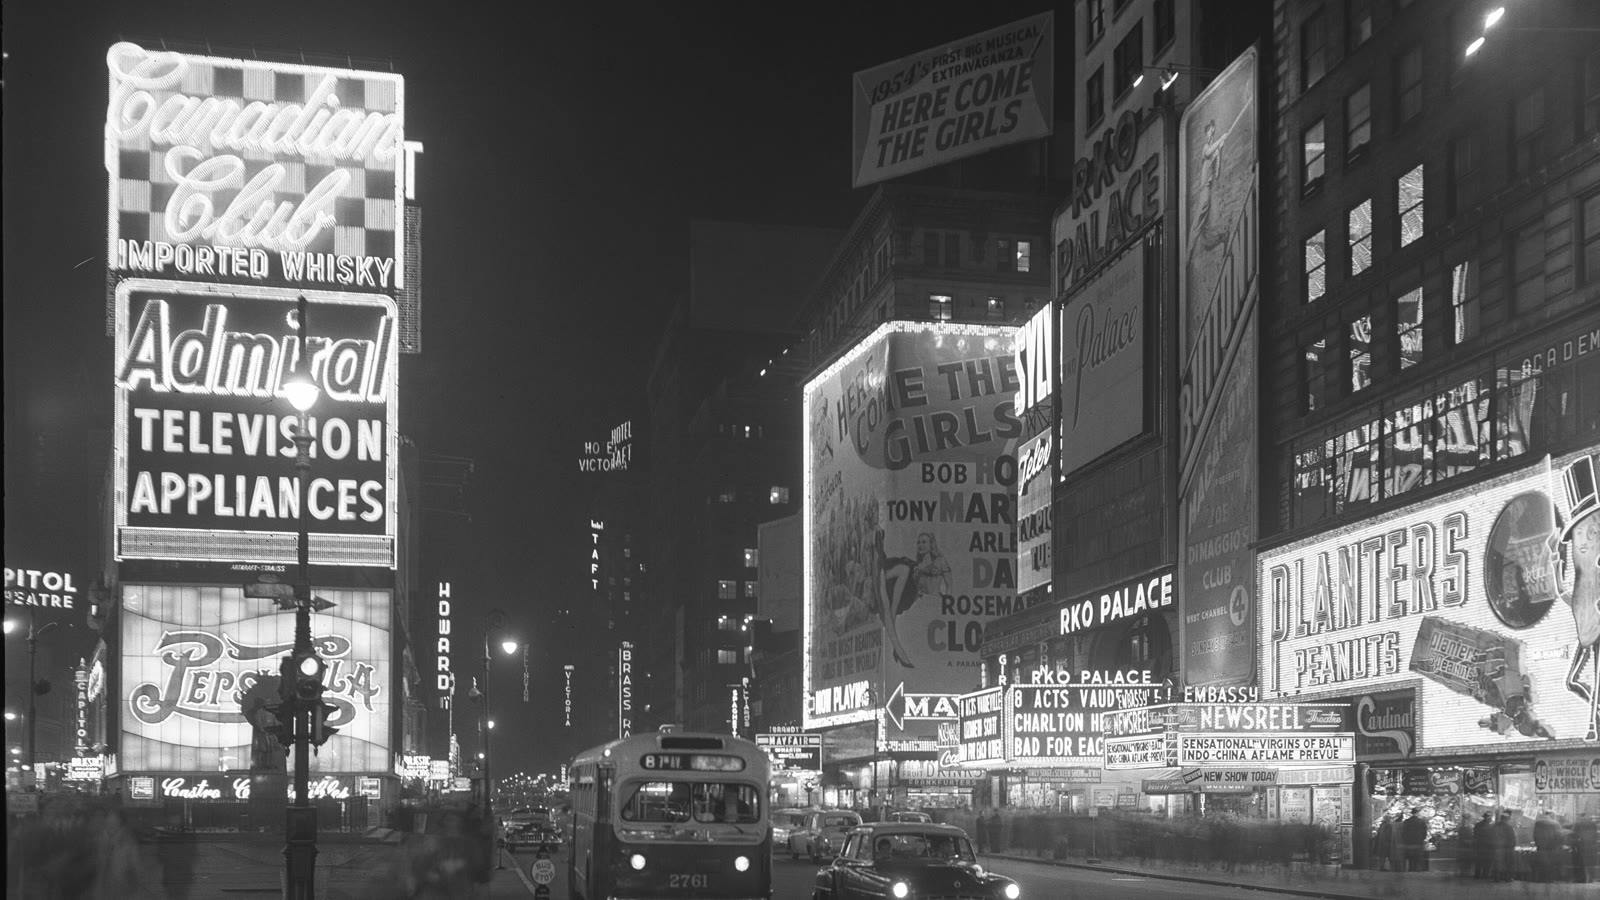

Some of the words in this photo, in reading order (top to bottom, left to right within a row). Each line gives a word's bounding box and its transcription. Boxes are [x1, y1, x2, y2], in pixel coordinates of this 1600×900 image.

[870, 60, 930, 106] 1954's
[932, 49, 961, 70] FIRST
[964, 42, 982, 59] BIG
[986, 24, 1040, 51] MUSICAL
[932, 46, 1024, 84] EXTRAVAGANZA
[106, 41, 400, 163] Canadian
[880, 86, 950, 135] HERE
[954, 60, 1035, 113] COME
[876, 125, 929, 169] THE
[935, 100, 1023, 151] GIRLS
[1071, 109, 1143, 220] RKO
[164, 145, 350, 251] Club
[1056, 152, 1160, 297] PALACE
[117, 238, 269, 279] IMPORTED
[280, 249, 394, 288] WHISKY
[115, 299, 395, 404] Admiral
[1072, 302, 1138, 433] Palace
[937, 353, 1018, 401] THE
[134, 407, 383, 462] TELEVISION
[611, 420, 632, 446] HOTEL
[884, 399, 1023, 472] GIRLS
[578, 458, 628, 472] VICTORA
[921, 462, 967, 484] BOB
[130, 470, 384, 523] APPLIANCES
[886, 500, 937, 523] TONY
[591, 533, 599, 590] TAFT
[1060, 599, 1094, 636] RKO
[1100, 573, 1174, 624] PALACE
[1232, 589, 1246, 621] 4
[1270, 510, 1468, 692] PLANTERS
[437, 582, 451, 691] HOWARD
[1293, 631, 1401, 691] PEANUTS
[622, 650, 633, 711] BRASS
[1031, 670, 1071, 685] RKO
[1080, 670, 1152, 685] PALACE
[1014, 689, 1023, 709] 8
[1034, 689, 1069, 709] ACTS
[1184, 686, 1260, 704] EMBASSY
[76, 682, 87, 747] CAPITOL
[1014, 712, 1084, 733] CHARLTON
[1113, 710, 1151, 736] NEWSREEL
[1200, 705, 1305, 731] NEWSREEL
[1357, 695, 1415, 750] Cardinal
[769, 736, 810, 746] MAYFAIR
[1014, 736, 1040, 757] BAD
[1048, 736, 1073, 757] FOR
[1251, 749, 1294, 760] AFLAME
[1299, 749, 1340, 760] PREVUE
[1303, 739, 1316, 749] OF
[645, 755, 655, 769] 8
[926, 762, 983, 779] DRINKS
[1203, 771, 1222, 783] NEW
[1224, 771, 1249, 783] SHOW
[1251, 770, 1278, 783] TODAY
[1556, 767, 1587, 777] WHOLE
[161, 777, 221, 799] Castro
[908, 779, 977, 787] FRANKFURTERS
[1547, 777, 1591, 790] CASHEWS
[535, 862, 552, 870] BUS
[669, 873, 708, 889] 2761
